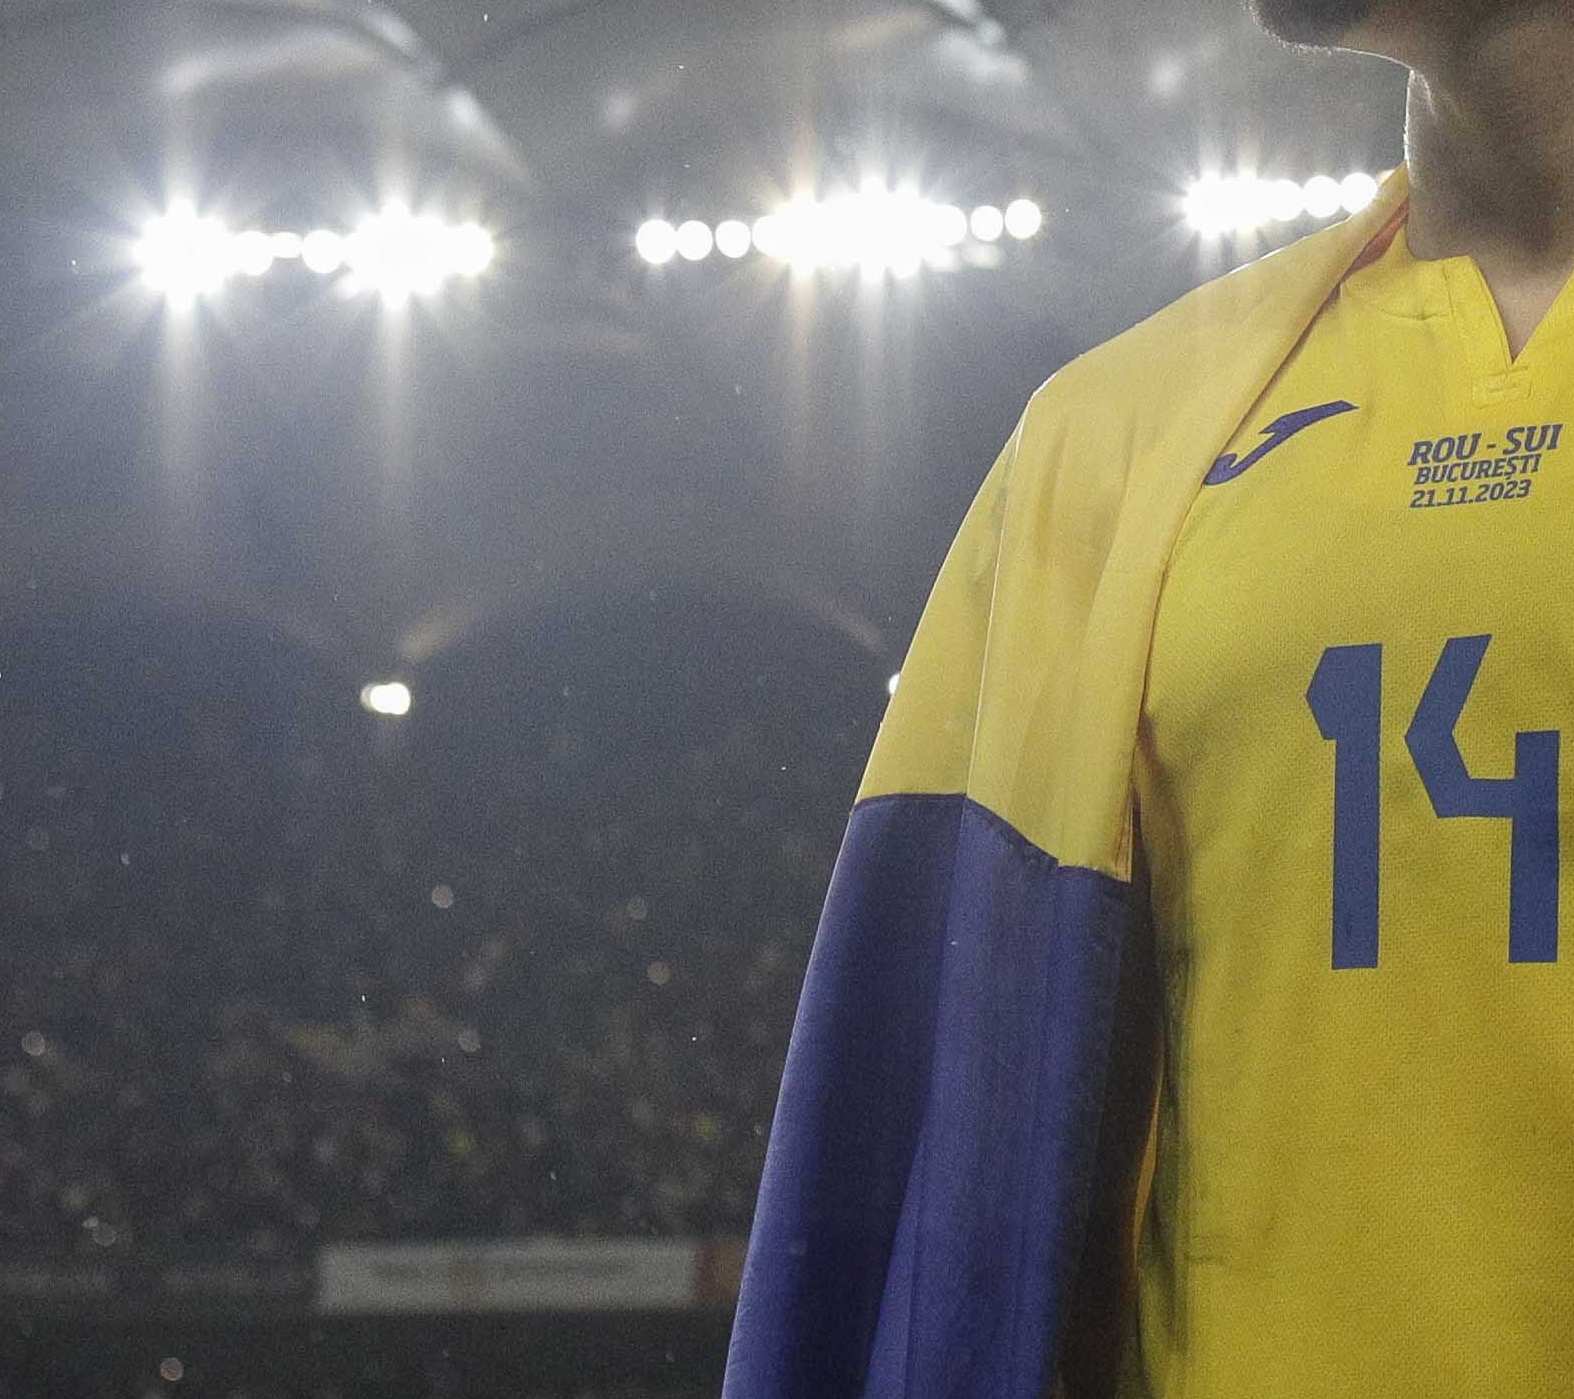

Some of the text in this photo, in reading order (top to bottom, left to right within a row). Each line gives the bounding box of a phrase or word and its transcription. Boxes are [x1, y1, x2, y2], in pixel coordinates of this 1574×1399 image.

[1407, 433, 1482, 465] ROU
[1502, 424, 1563, 454] SUI
[1409, 479, 1532, 508] 21.11.2023
[1306, 634, 1560, 970] 14
